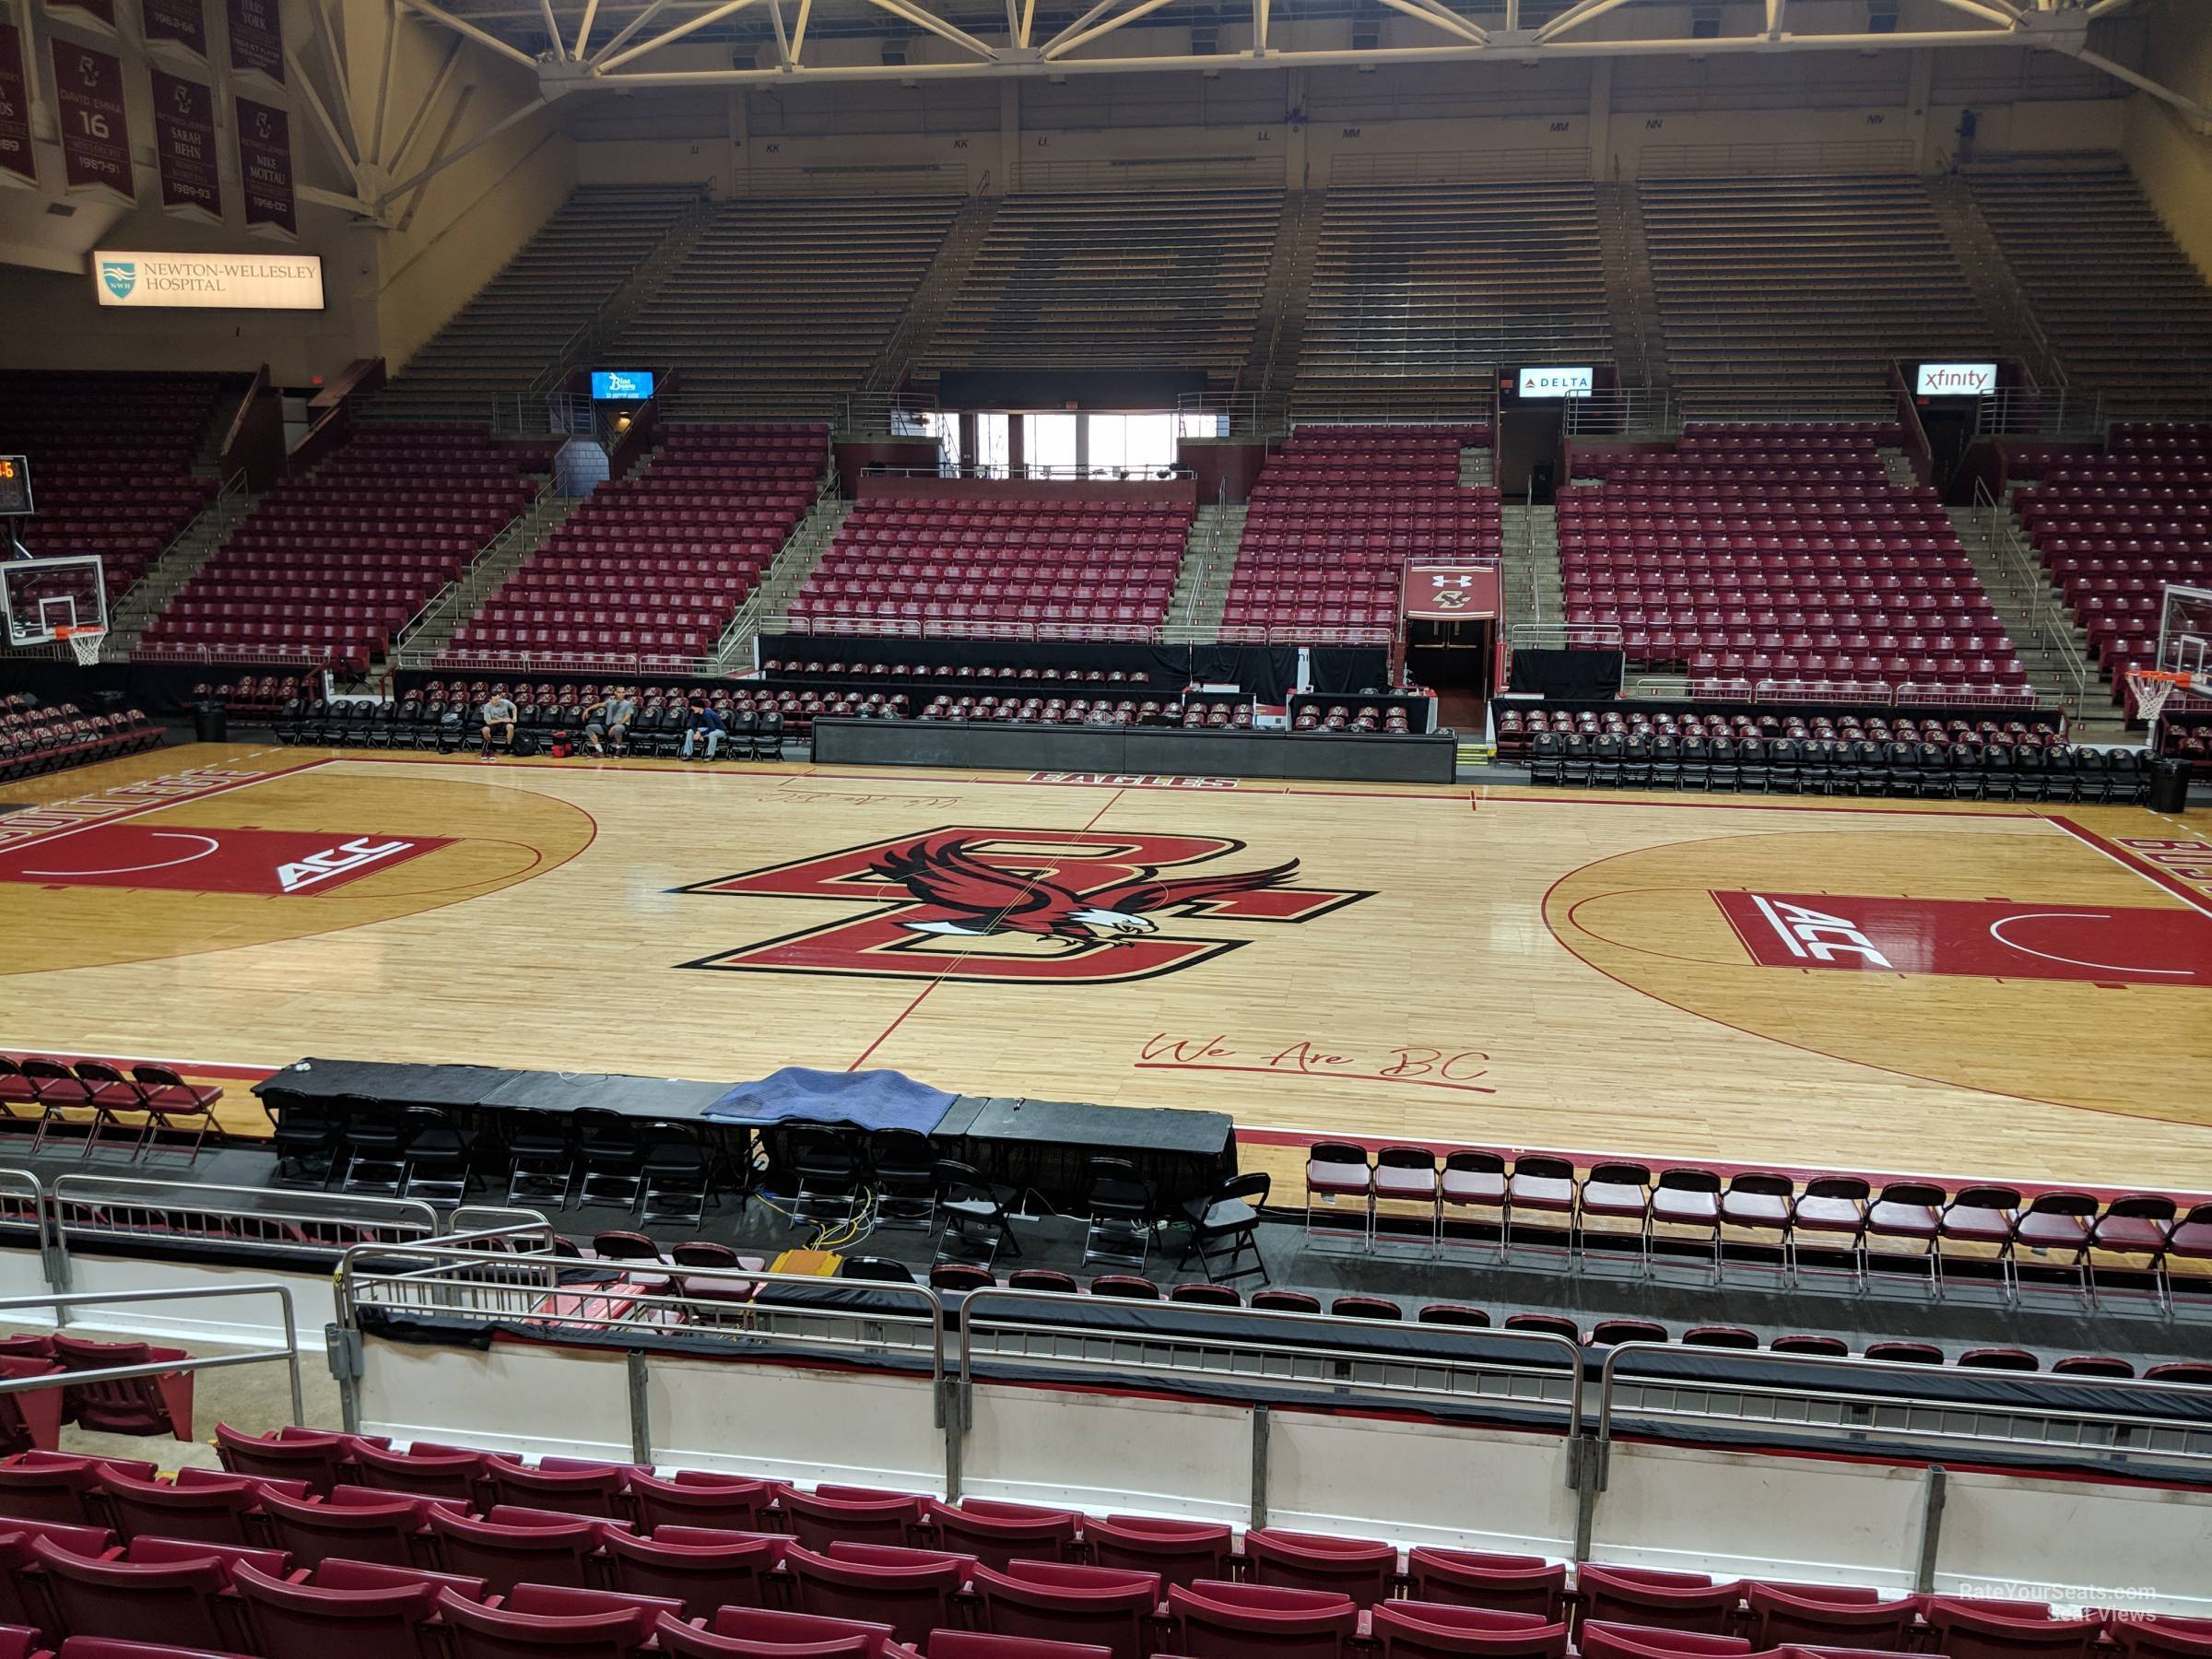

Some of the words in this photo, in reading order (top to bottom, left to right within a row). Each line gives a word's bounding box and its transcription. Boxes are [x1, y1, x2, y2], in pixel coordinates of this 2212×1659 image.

[79, 111, 110, 139] 16
[144, 263, 316, 279] NEWTON-WELLESLEY
[147, 277, 226, 292] HOSPITAL
[1540, 377, 1588, 387] DELTA
[1925, 370, 1988, 390] xfinity
[1027, 771, 1240, 788] EAGLES
[277, 836, 404, 888] ACC
[1772, 900, 1894, 969] ACC
[1141, 1033, 1237, 1063] We
[1261, 1041, 1355, 1074] Are
[1380, 1048, 1490, 1080] BC
